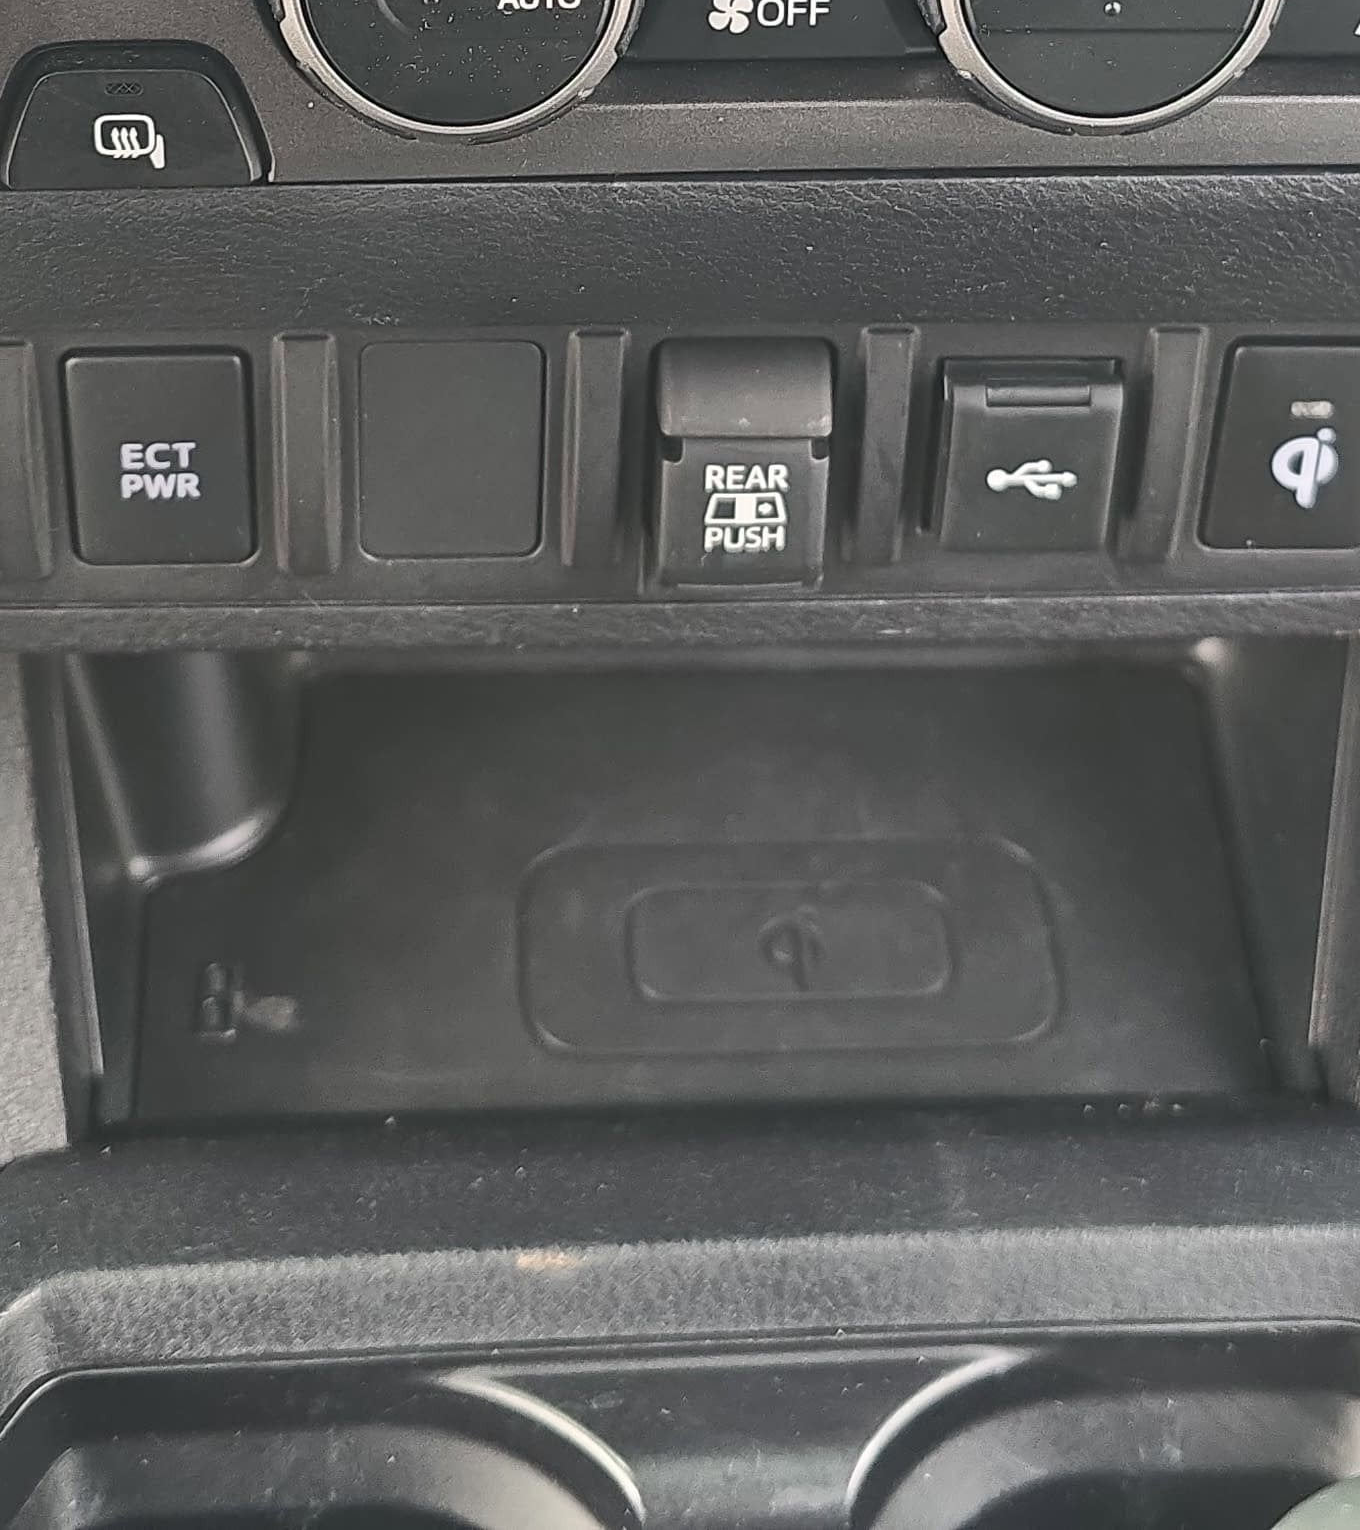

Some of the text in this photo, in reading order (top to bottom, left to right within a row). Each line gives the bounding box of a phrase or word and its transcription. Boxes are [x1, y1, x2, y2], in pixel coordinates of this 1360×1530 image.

[121, 443, 195, 469] ECT
[121, 473, 200, 499] PWR
[706, 465, 788, 490] REAR
[705, 526, 784, 551] PUSH
